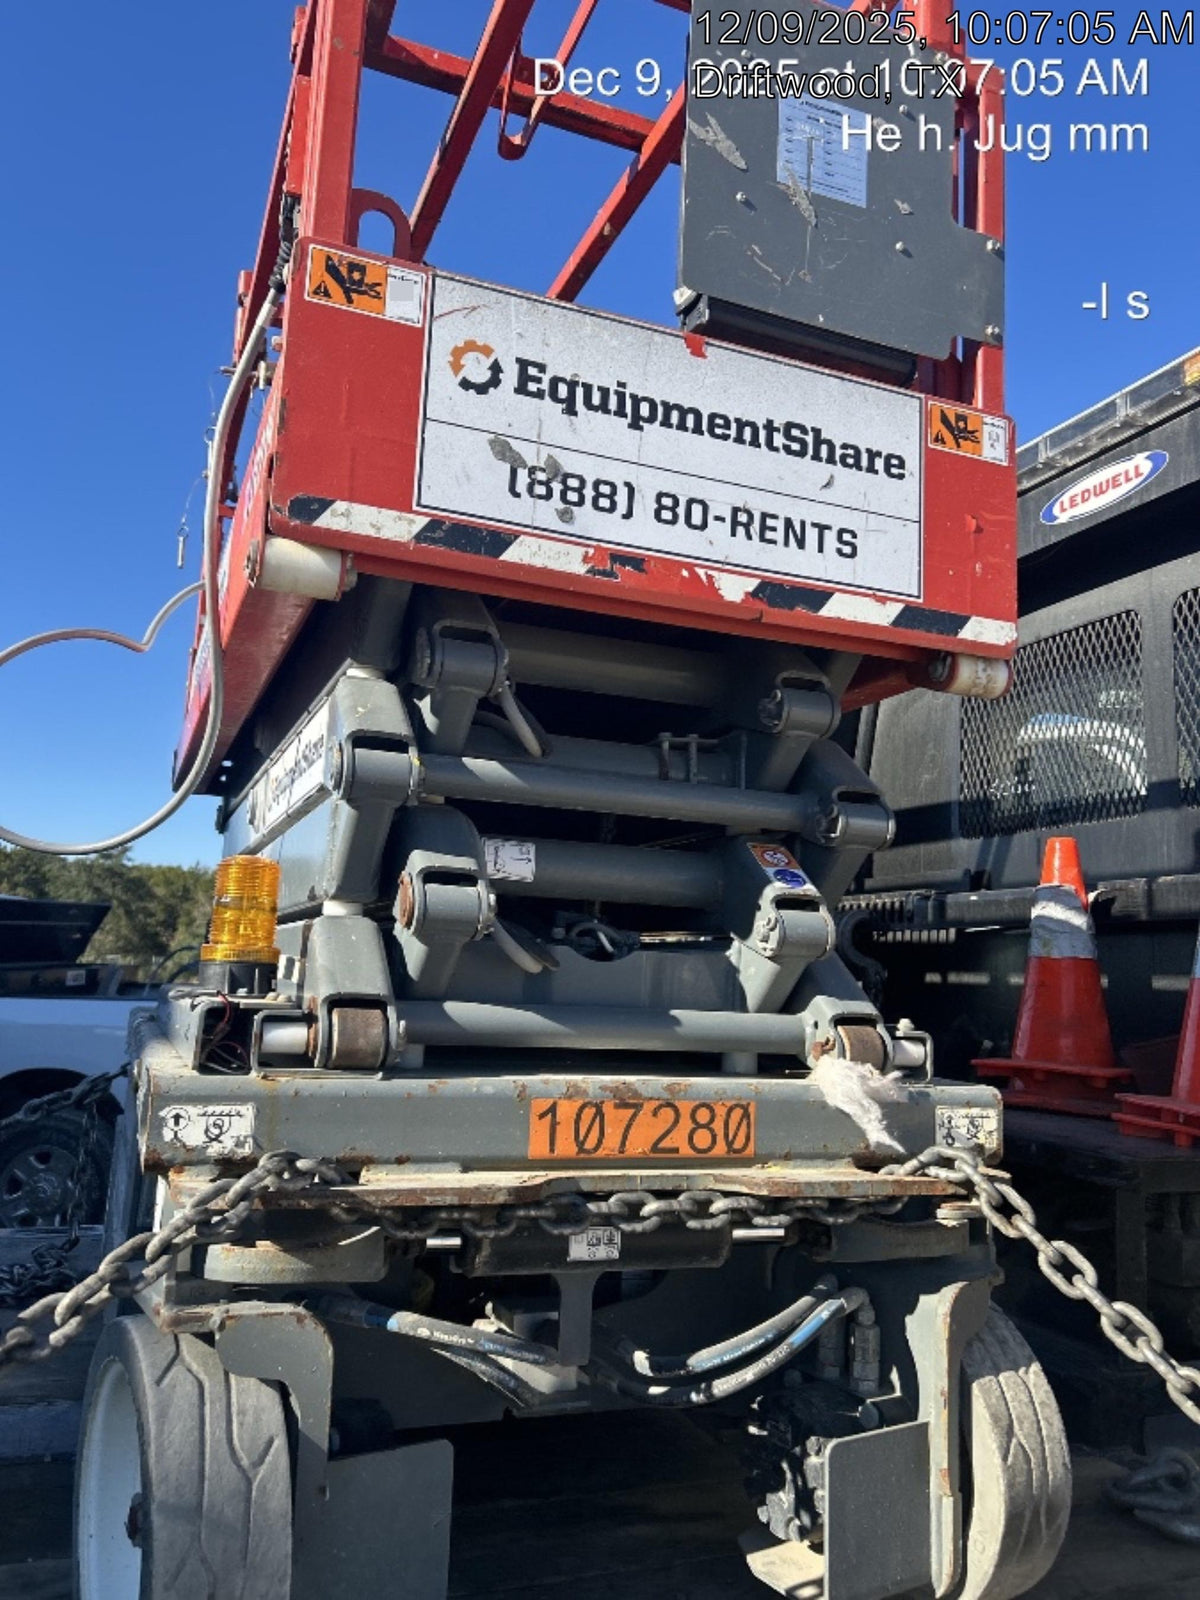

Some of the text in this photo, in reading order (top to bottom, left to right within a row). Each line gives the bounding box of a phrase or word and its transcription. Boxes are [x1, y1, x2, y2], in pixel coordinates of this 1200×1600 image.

[513, 356, 907, 481] EquipmentShare
[507, 462, 858, 560] (888) 80-RENTS
[1059, 464, 1144, 513] LEDWELL
[538, 1101, 751, 1155] 107280
